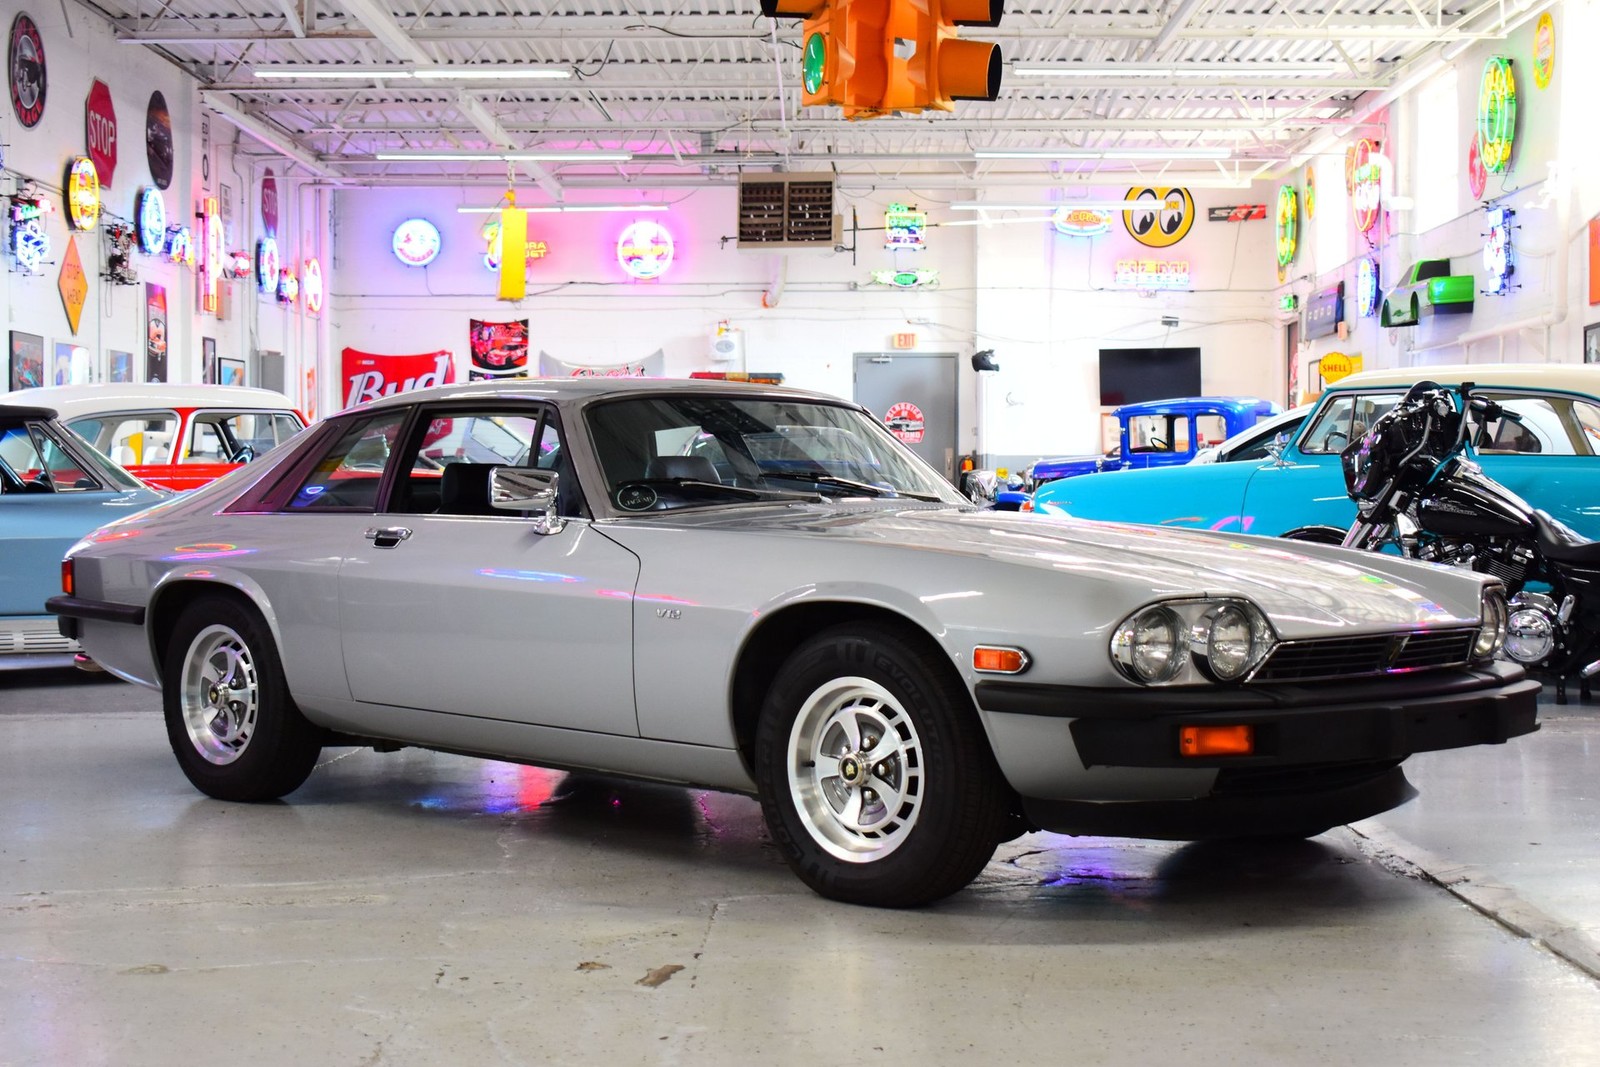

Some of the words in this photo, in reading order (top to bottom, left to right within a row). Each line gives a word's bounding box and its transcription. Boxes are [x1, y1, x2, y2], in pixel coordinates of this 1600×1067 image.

[13, 84, 43, 125] GARAGE
[90, 110, 115, 158] STOP
[264, 188, 278, 216] STOP
[1210, 206, 1265, 221] SRT
[1308, 305, 1332, 320] FORD
[898, 333, 915, 348] EXIT
[1323, 363, 1348, 373] SHELL
[345, 354, 449, 410] Bud
[656, 608, 682, 619] V12
[875, 654, 944, 785] EVOLUTION
